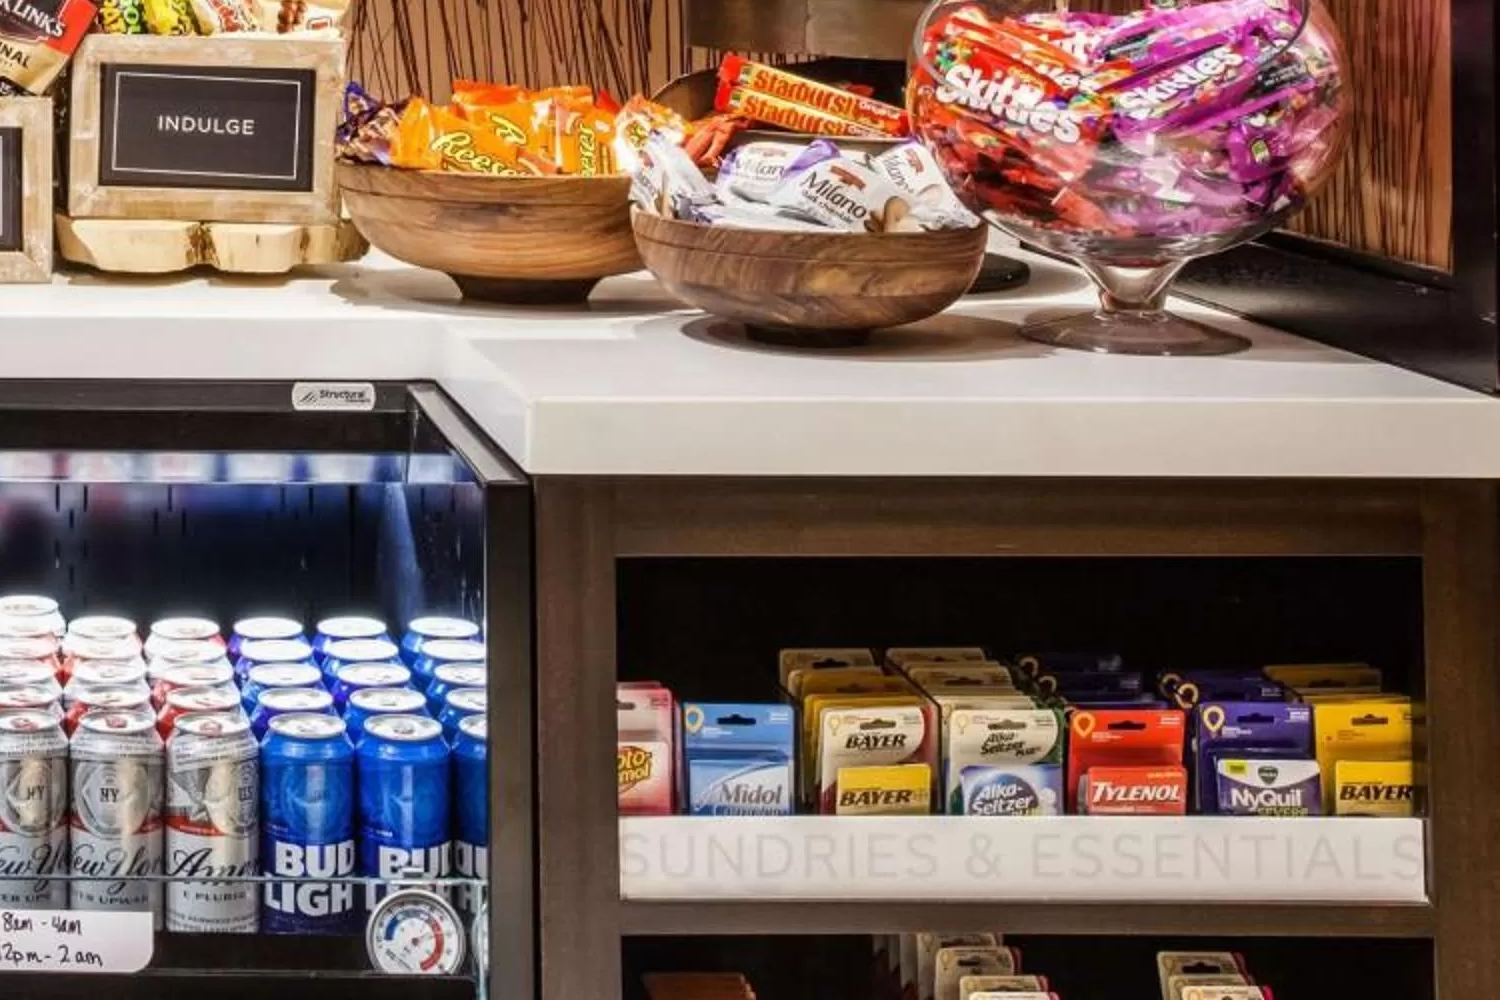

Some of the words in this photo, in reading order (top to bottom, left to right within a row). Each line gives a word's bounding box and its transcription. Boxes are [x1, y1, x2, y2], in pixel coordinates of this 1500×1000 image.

[753, 68, 860, 119] Starburst
[1112, 44, 1243, 120] Skittles
[935, 63, 1081, 143] Skittles
[157, 114, 255, 135] INDULGE
[801, 170, 868, 220] Milano
[845, 733, 908, 751] BAYER
[719, 782, 783, 804] Midol
[840, 788, 913, 807] BAYER
[975, 782, 1023, 801] Alka-
[1091, 780, 1182, 804] TYLENOL
[1230, 787, 1302, 811] NyQuil
[1340, 784, 1413, 801] BAYER
[971, 794, 1034, 816] Seltzer
[275, 839, 355, 879] BUD
[622, 832, 940, 880] SUNDRIES
[962, 832, 1002, 881] &
[1031, 832, 1424, 882] ESSENTIALS
[264, 872, 353, 917] LIGH
[2, 911, 34, 932] 8am
